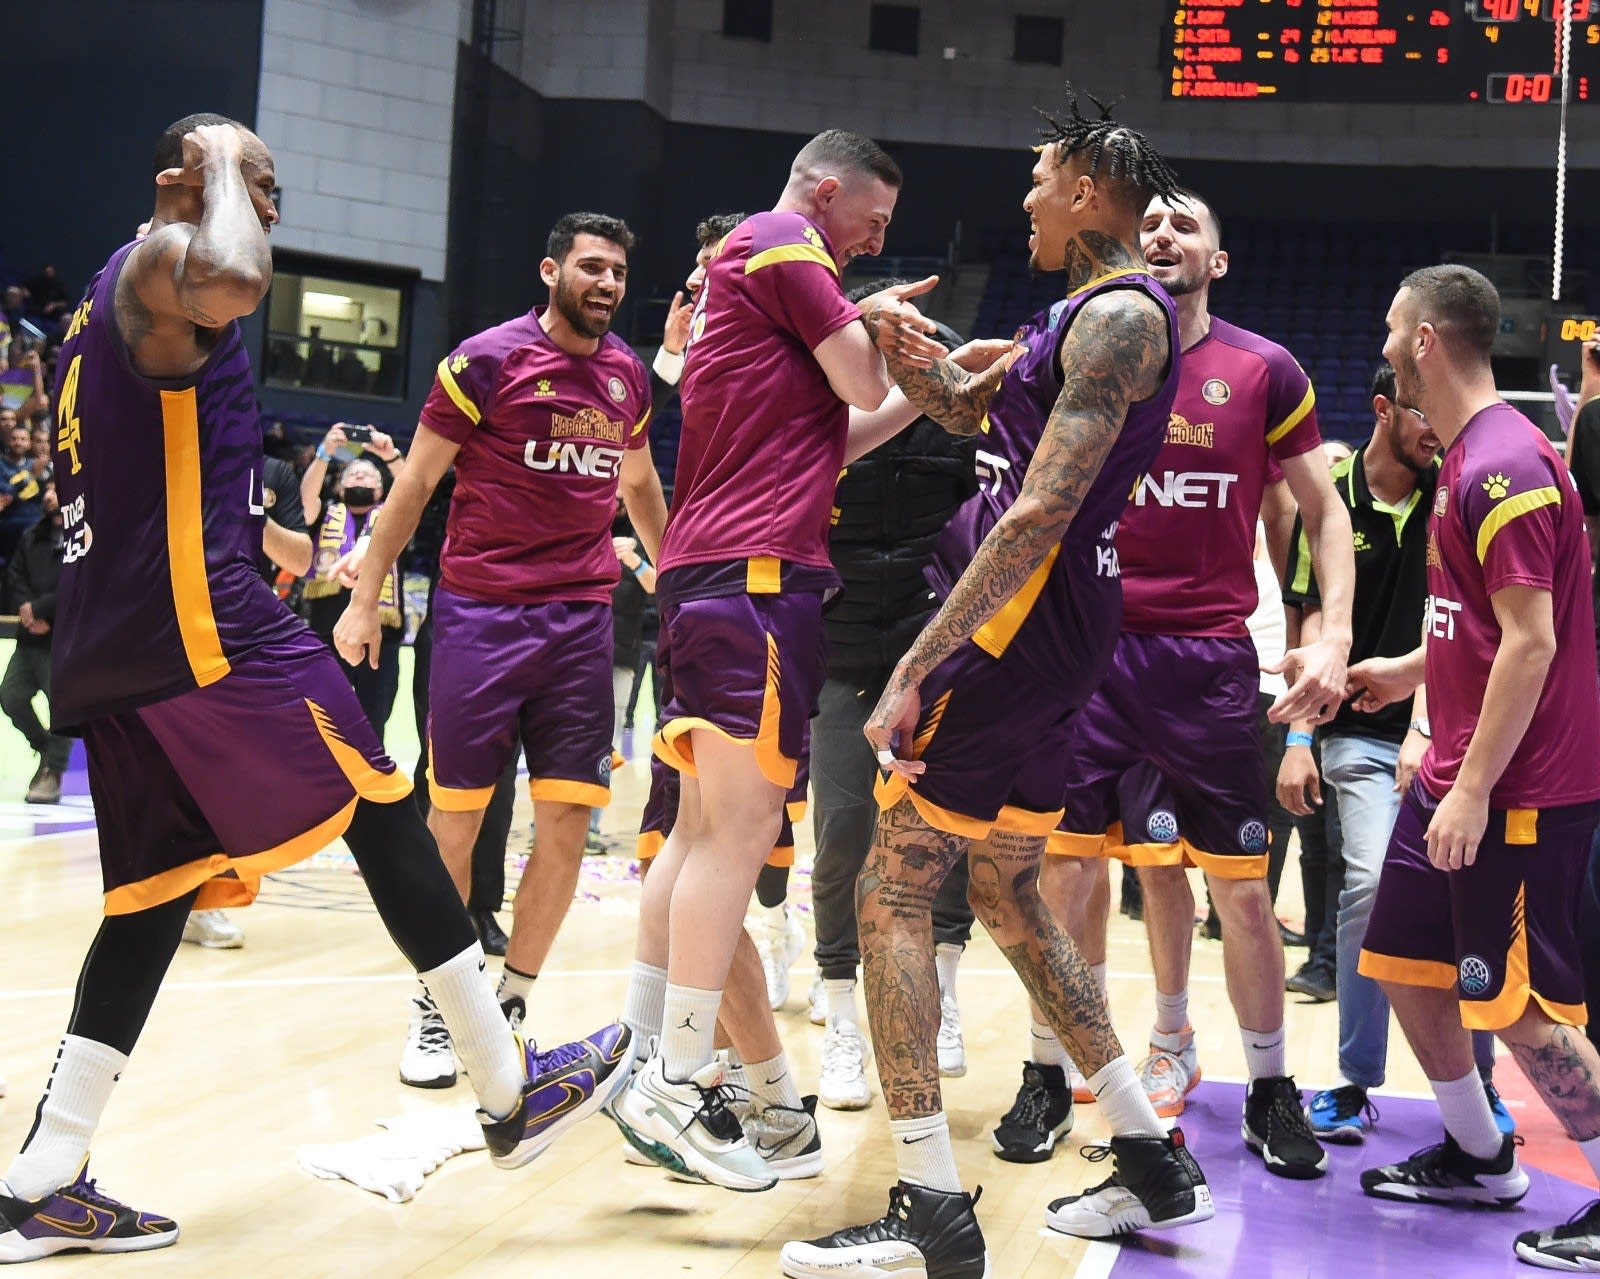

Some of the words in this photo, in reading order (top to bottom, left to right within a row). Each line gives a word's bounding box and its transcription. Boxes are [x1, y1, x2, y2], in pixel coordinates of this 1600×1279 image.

[1174, 10, 1186, 25] 2
[1174, 28, 1185, 43] 3
[1312, 29, 1331, 44] 21
[1485, 25, 1499, 43] 4
[1586, 24, 1600, 44] 5
[1174, 47, 1184, 60] 4
[1437, 48, 1449, 63] 5
[1505, 74, 1552, 103] 0:0
[1561, 319, 1596, 342] 0:0
[551, 412, 595, 439] HAPOEL
[595, 421, 625, 444] HOLON
[1134, 470, 1239, 510] NET
